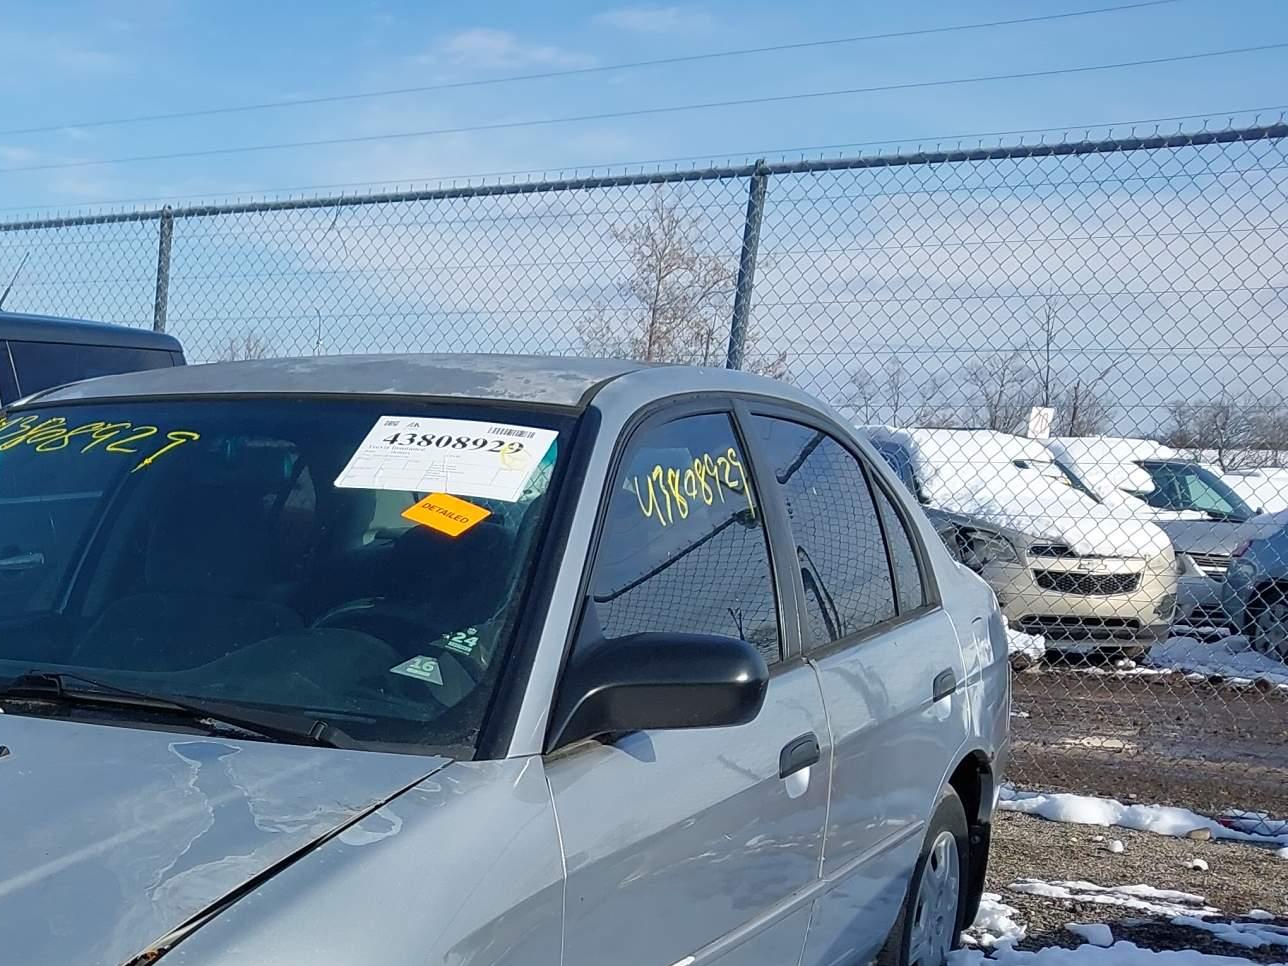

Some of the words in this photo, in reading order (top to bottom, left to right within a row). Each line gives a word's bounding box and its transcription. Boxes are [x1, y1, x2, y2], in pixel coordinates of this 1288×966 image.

[382, 431, 525, 455] 43808929
[634, 448, 756, 527] 43808929
[421, 502, 470, 525] DETAILED
[451, 631, 479, 647] 24
[409, 658, 436, 672] 16
